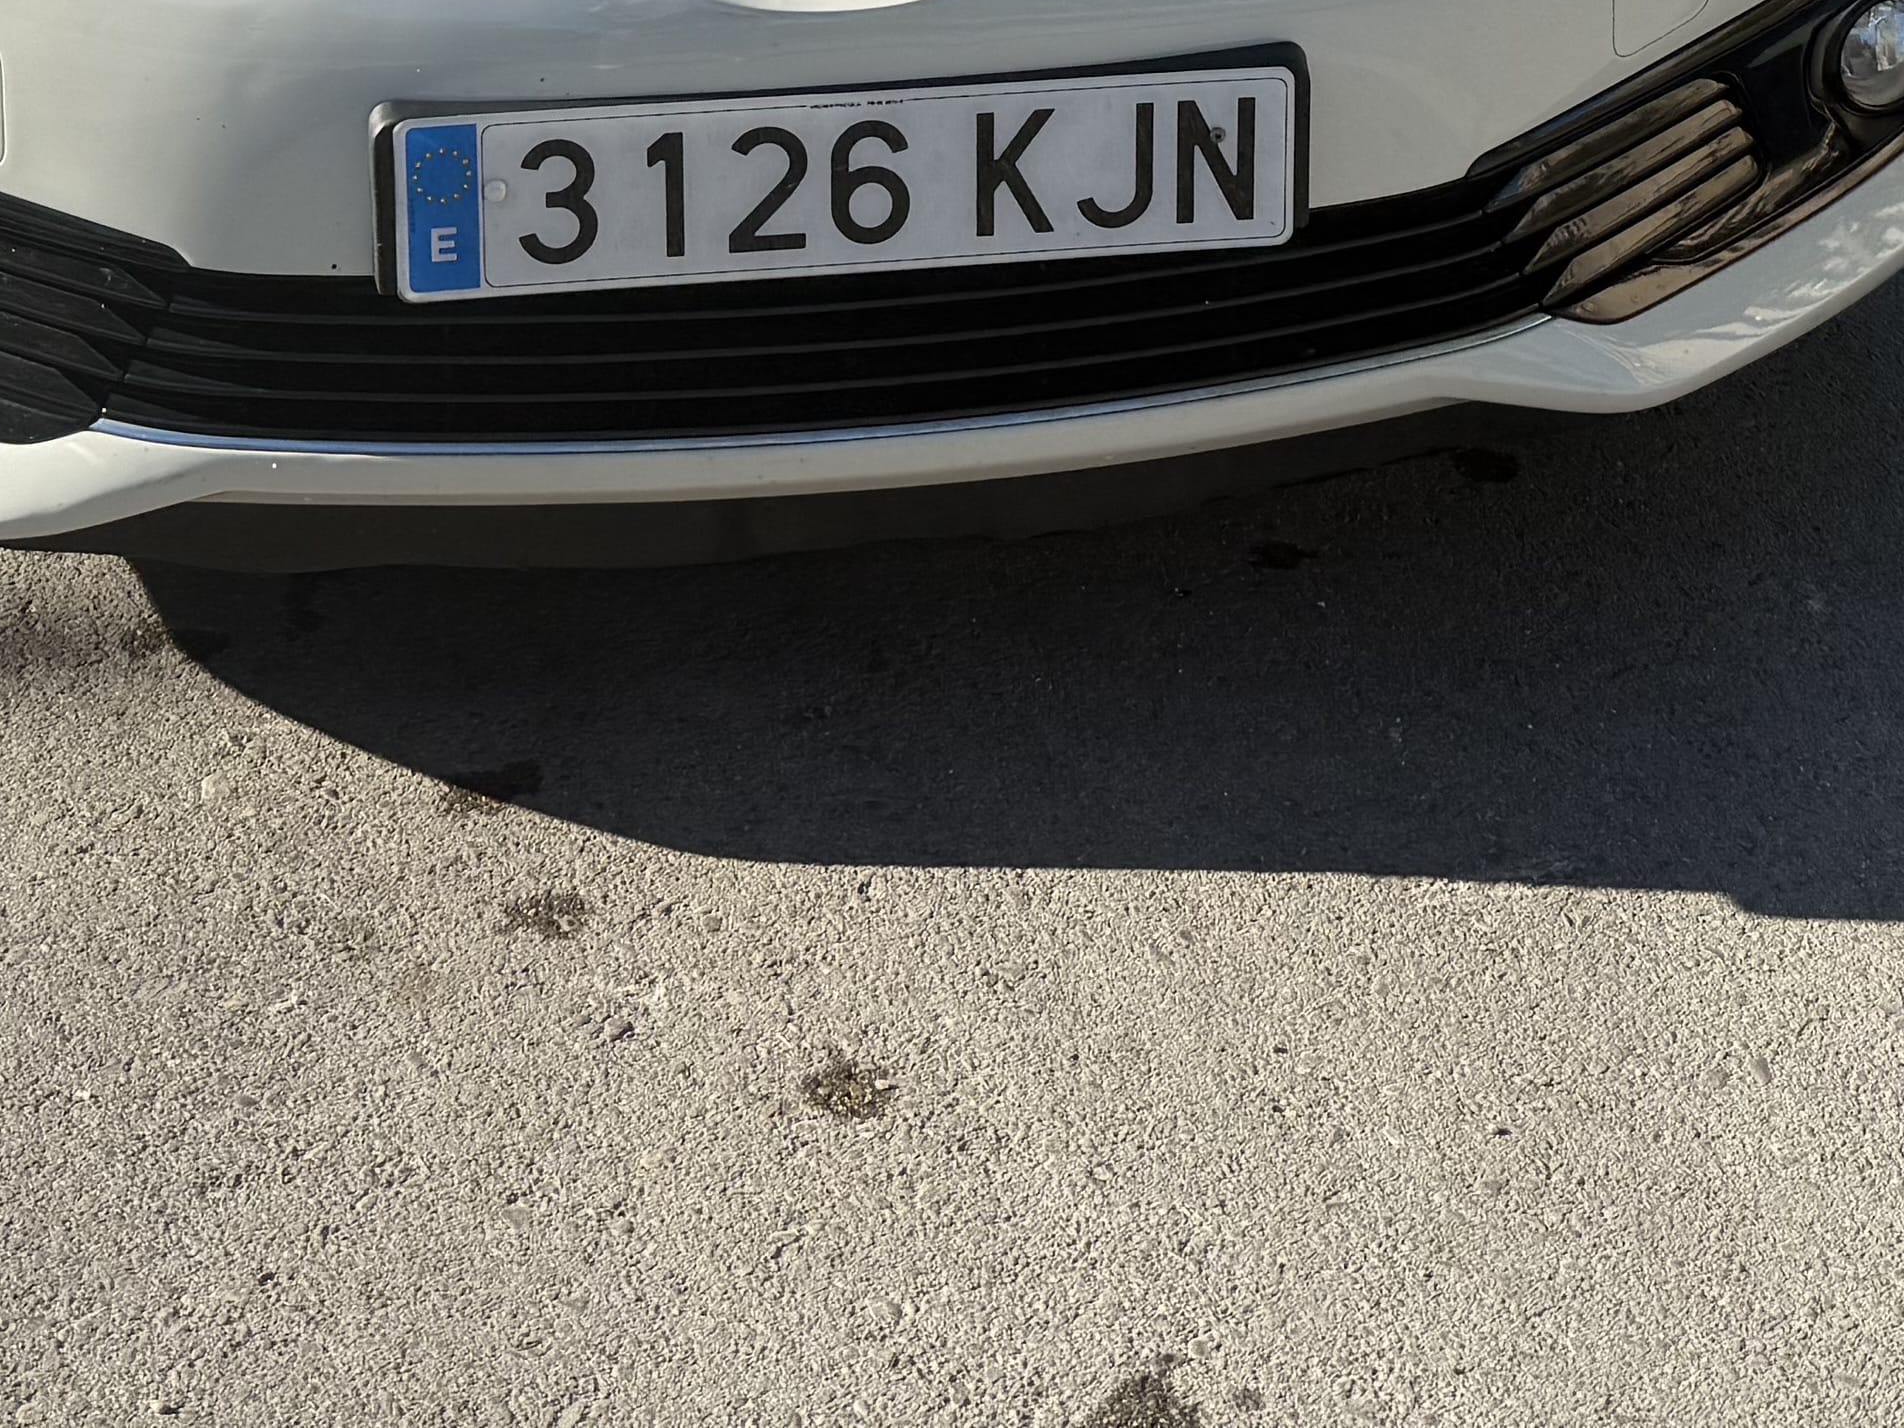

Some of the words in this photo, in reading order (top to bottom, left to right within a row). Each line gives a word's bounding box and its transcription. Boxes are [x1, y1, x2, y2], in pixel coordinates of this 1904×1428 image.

[517, 118, 911, 265] 3126
[973, 96, 1256, 237] KJN
[430, 226, 458, 263] E
